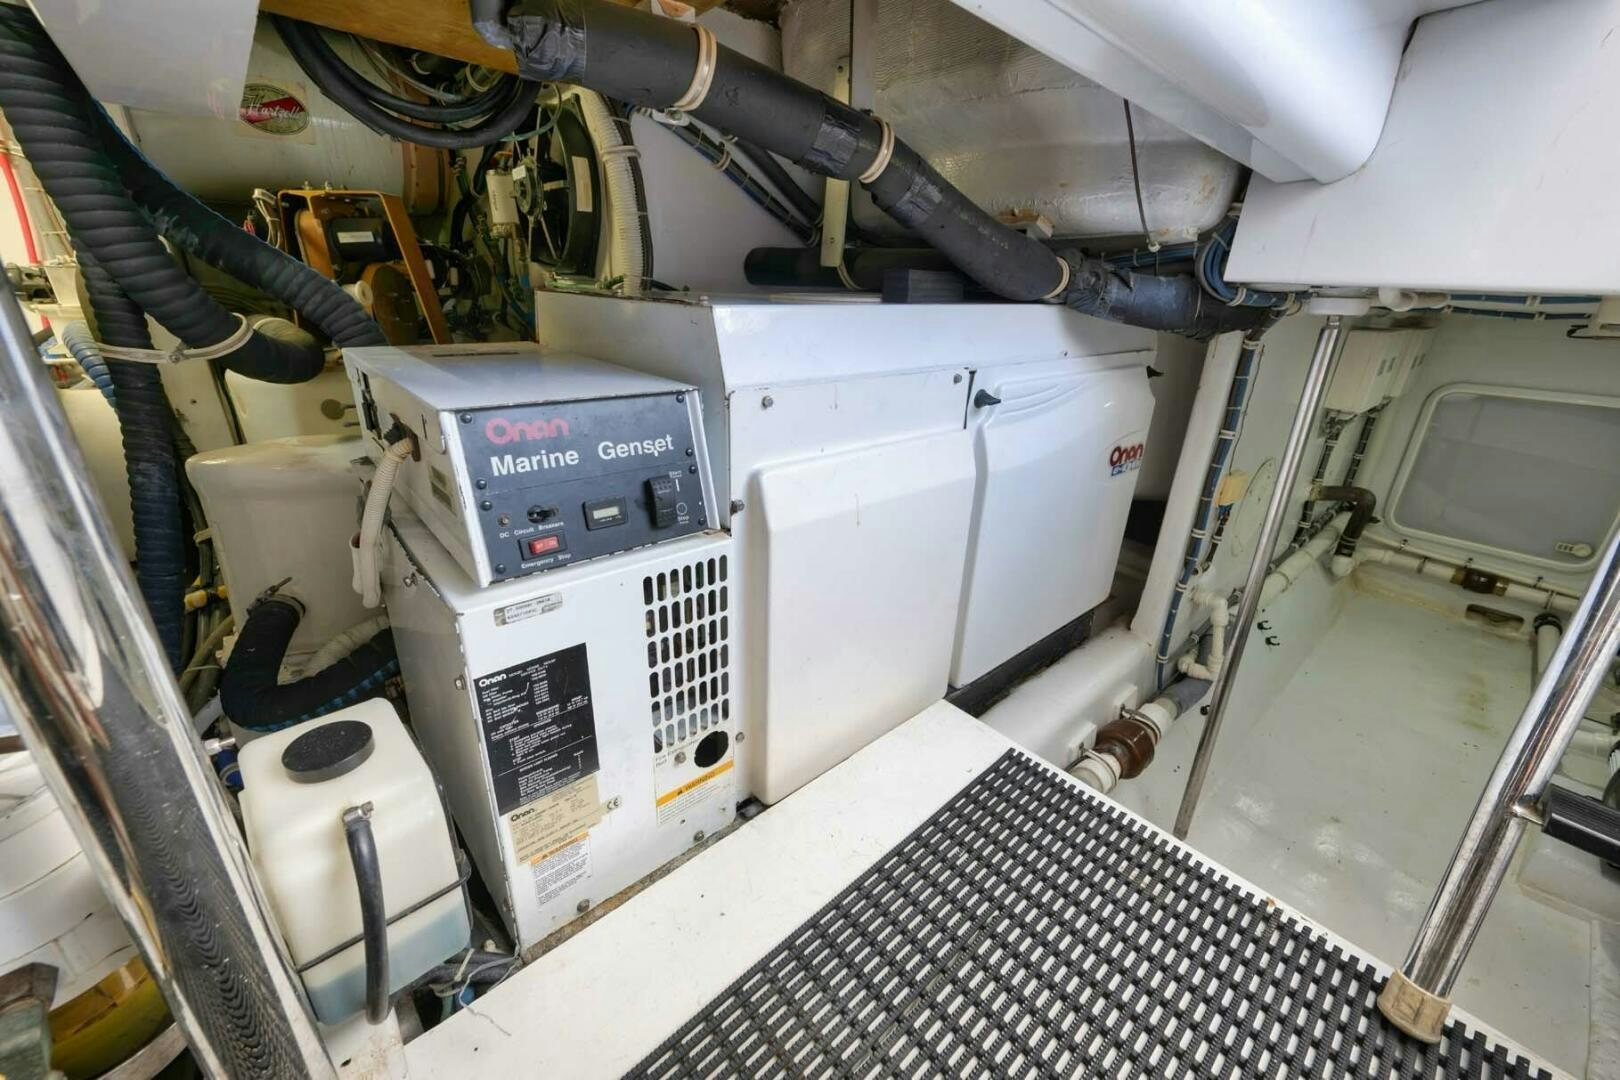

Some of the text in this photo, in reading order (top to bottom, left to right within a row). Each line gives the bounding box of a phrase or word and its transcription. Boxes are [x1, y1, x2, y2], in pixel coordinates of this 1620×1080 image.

[485, 417, 570, 445] Onan
[490, 434, 674, 477] Marine Genset
[478, 673, 507, 688] Onan
